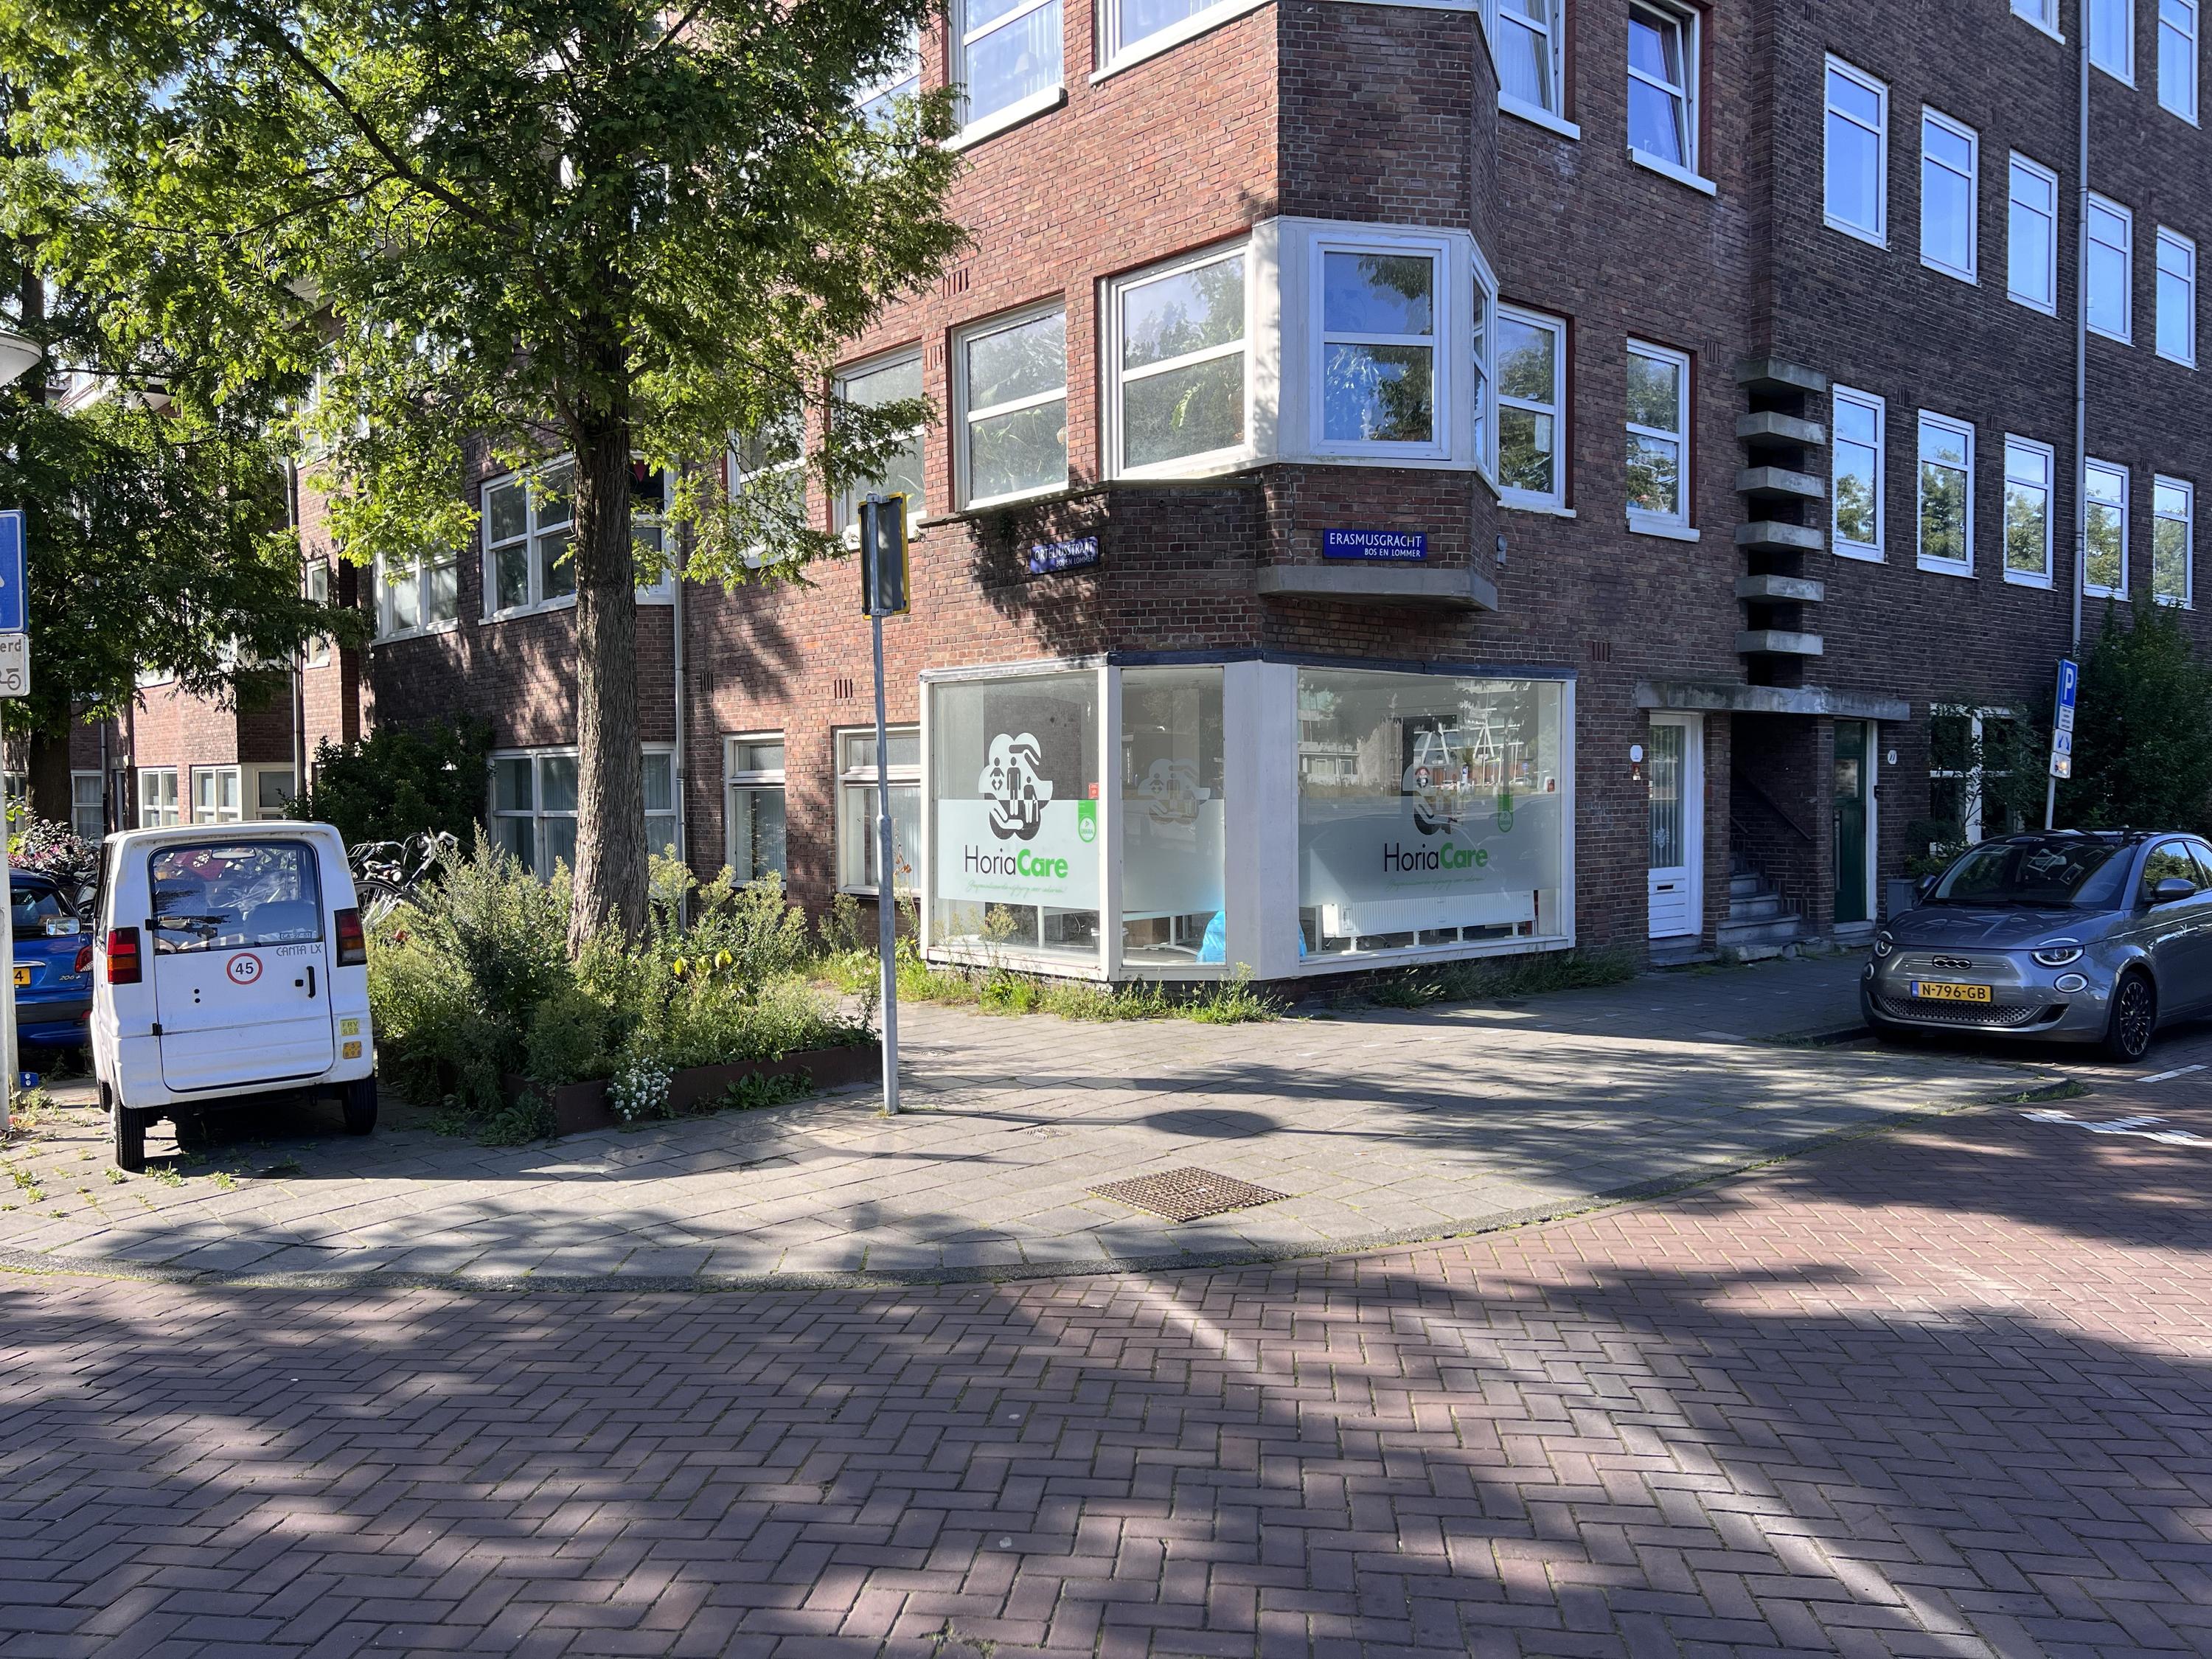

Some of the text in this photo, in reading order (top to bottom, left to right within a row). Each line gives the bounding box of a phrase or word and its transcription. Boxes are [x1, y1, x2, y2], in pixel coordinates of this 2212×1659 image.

[1329, 532, 1422, 547] ERASMUSGRACHT
[1034, 541, 1093, 560] ORTELIUSSTRAAT
[1364, 548, 1377, 556] BOS
[1391, 549, 1421, 557] LOMMER
[1056, 559, 1065, 568] BOS
[1074, 555, 1094, 565] LOMMER
[2064, 667, 2073, 700] P
[965, 844, 1068, 878] HoriaCare
[1384, 842, 1488, 872] HoriaCare
[276, 944, 321, 956] CANTA LX
[235, 962, 254, 975] 45
[1922, 984, 1986, 999] N-796-GB
